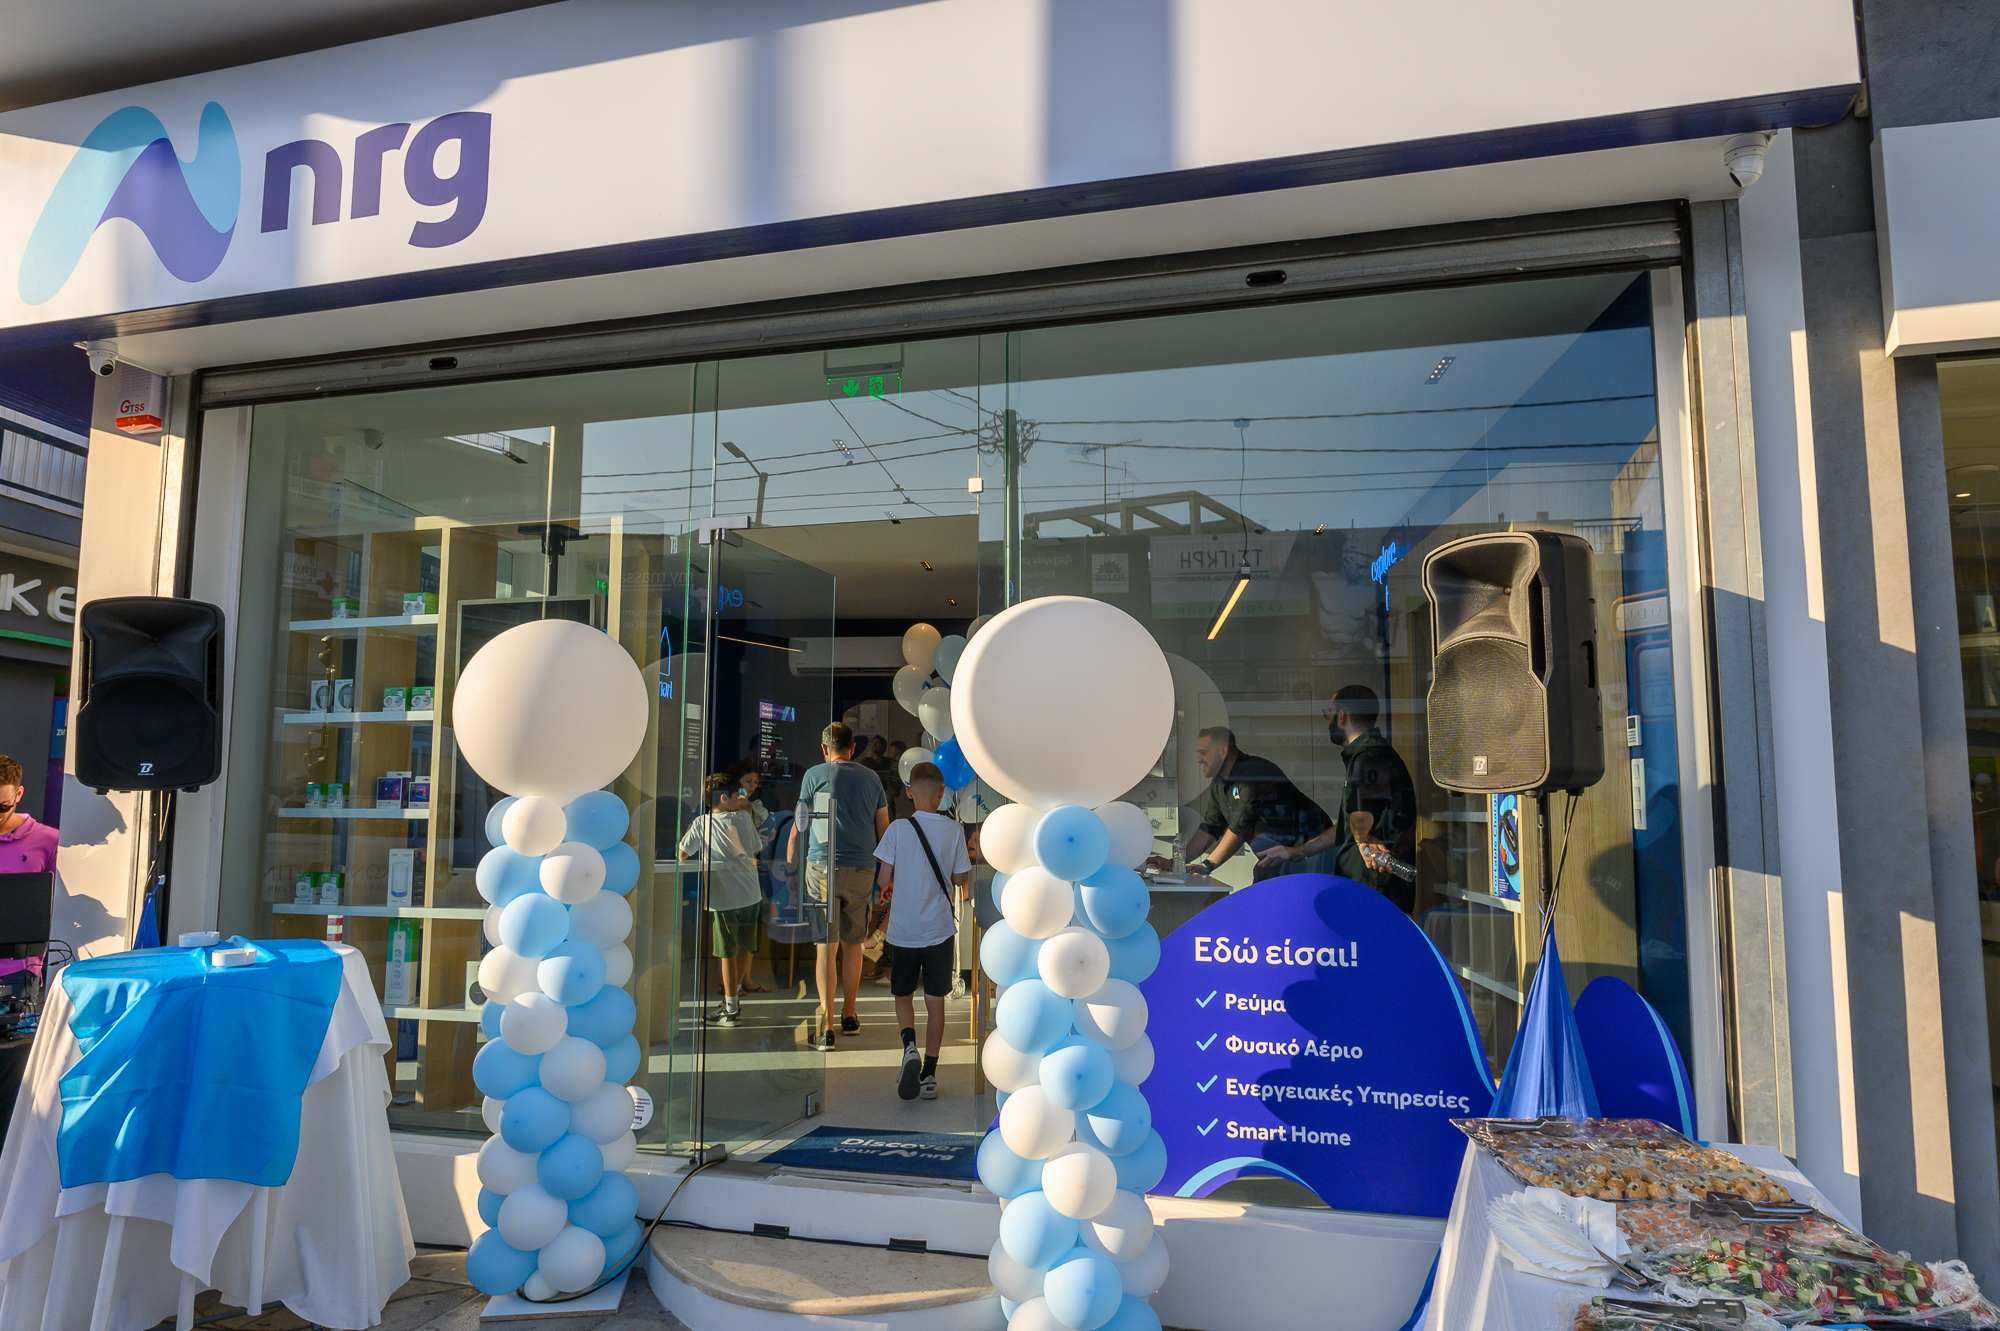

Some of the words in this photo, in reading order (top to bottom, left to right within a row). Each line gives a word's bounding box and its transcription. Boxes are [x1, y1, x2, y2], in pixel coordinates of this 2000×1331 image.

[261, 111, 492, 248] nrg
[980, 803, 992, 815] nrg
[1194, 936, 1259, 965] Εδώ
[1265, 938, 1358, 968] είσαι!
[1225, 993, 1287, 1016] Ρεύμα
[1225, 1034, 1300, 1056] Φυσικό
[1303, 1039, 1364, 1062] Αέριο
[1226, 1077, 1354, 1106] Ενεργειακές
[1356, 1085, 1470, 1114] Υπηρεσίες
[840, 1138, 965, 1152] Discover
[1226, 1121, 1288, 1142] Smart
[1291, 1125, 1352, 1147] Home
[829, 1147, 882, 1155] your
[919, 1153, 955, 1161] nrg
